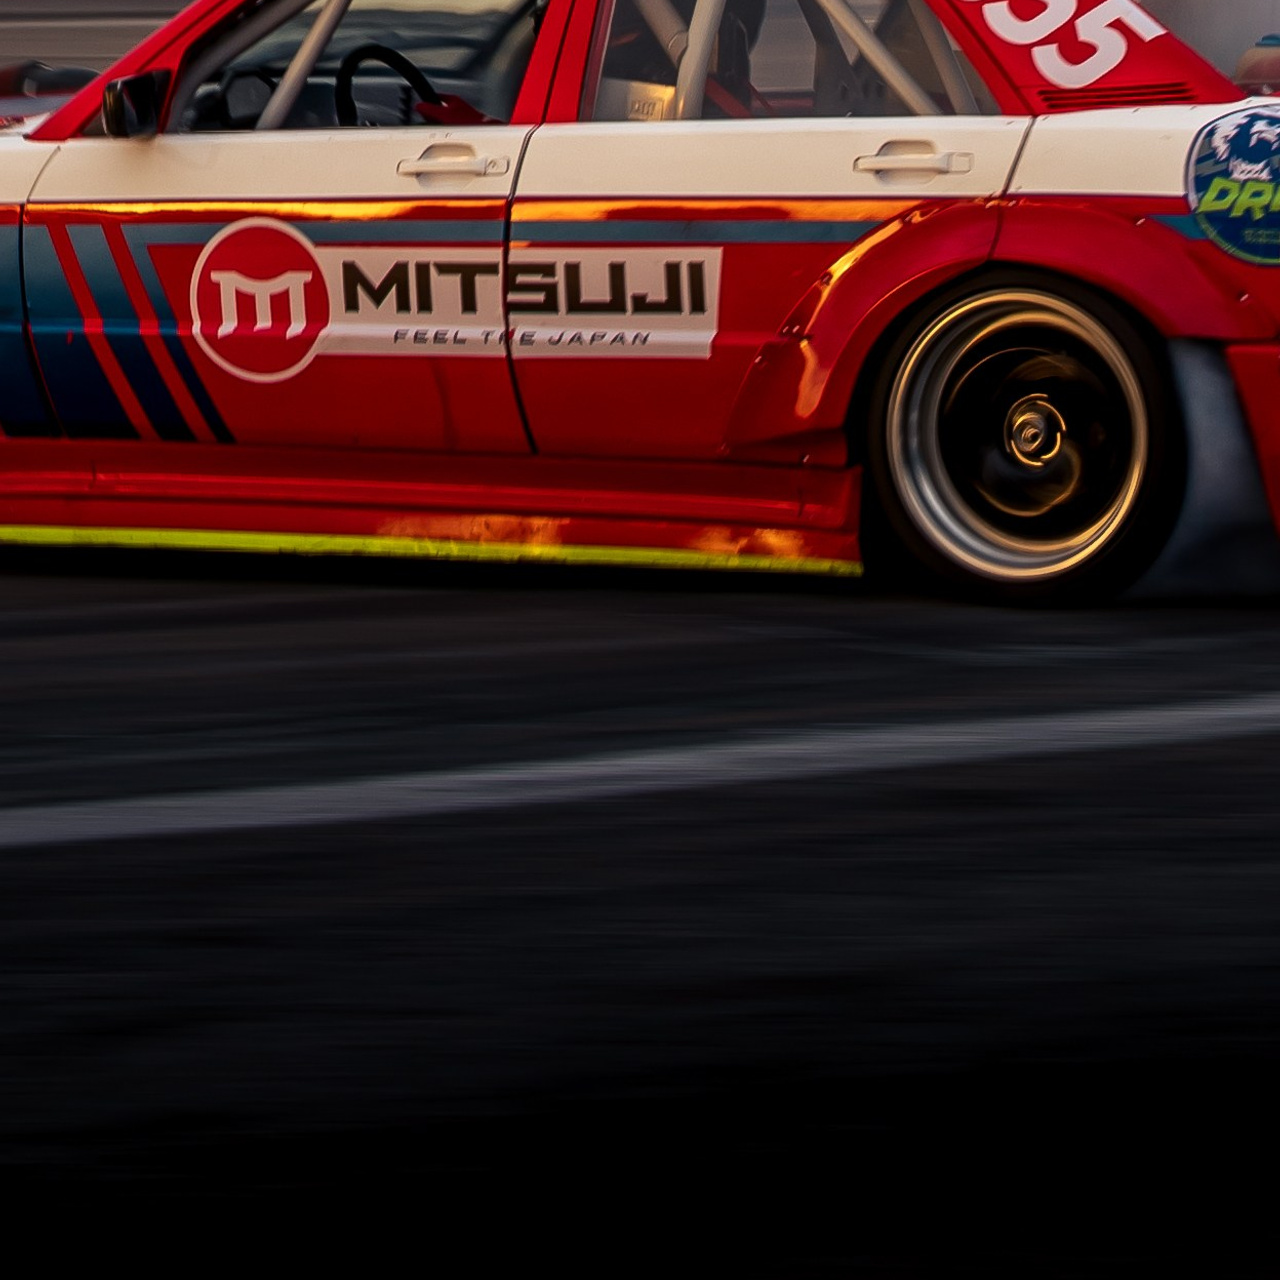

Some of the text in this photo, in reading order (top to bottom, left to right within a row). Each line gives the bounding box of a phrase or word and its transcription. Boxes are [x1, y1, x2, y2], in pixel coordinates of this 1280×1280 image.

[342, 260, 708, 315] MITSUJI
[393, 328, 467, 345] FEEL
[547, 330, 651, 346] JAPAN
